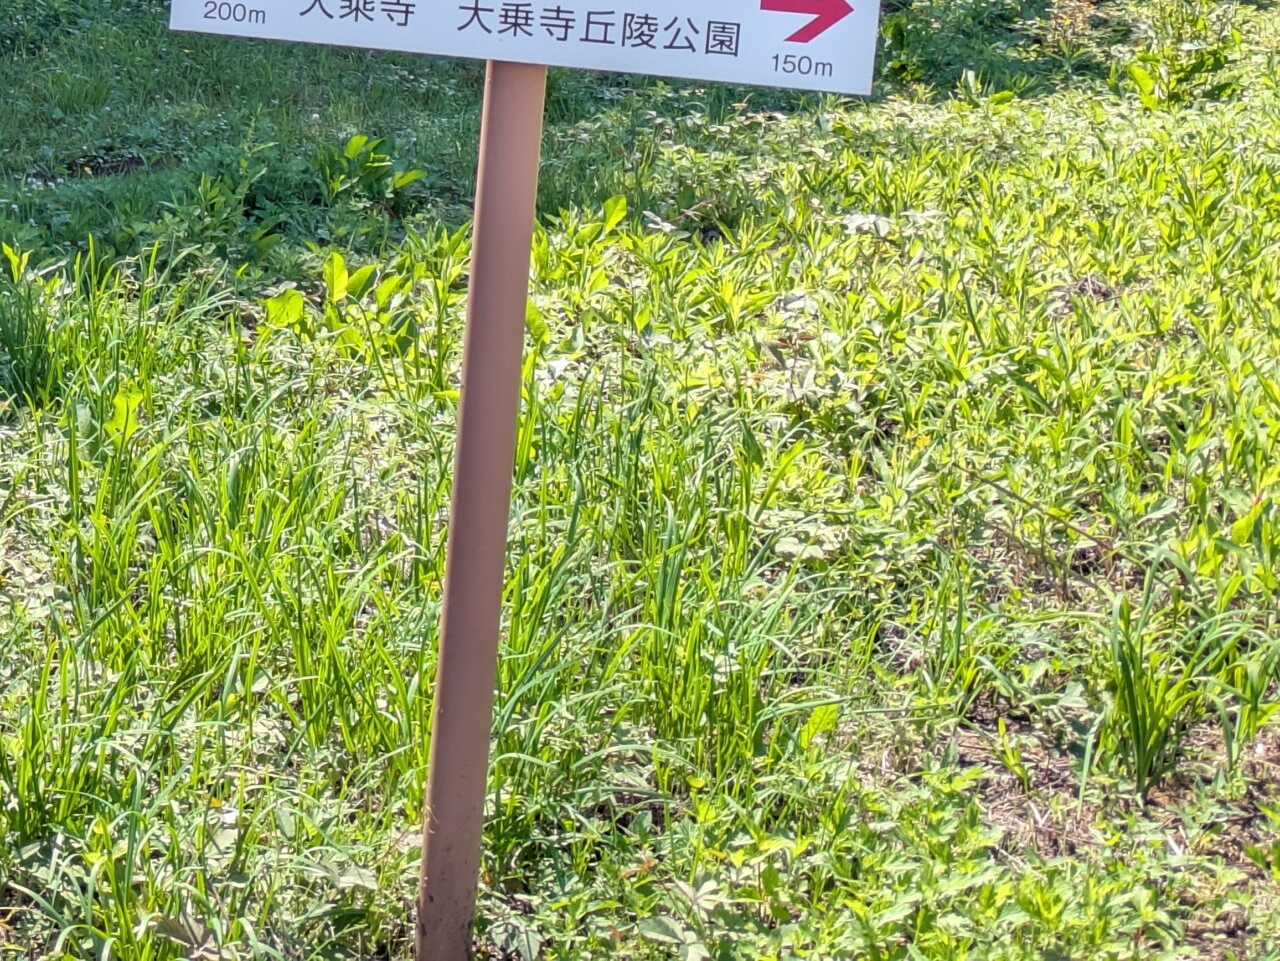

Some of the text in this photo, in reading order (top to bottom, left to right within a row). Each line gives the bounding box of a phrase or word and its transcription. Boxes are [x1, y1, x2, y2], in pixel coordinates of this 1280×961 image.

[203, 0, 266, 24] 200m
[456, 0, 741, 59] 大乗寺丘陵公園
[771, 53, 833, 77] 150m
